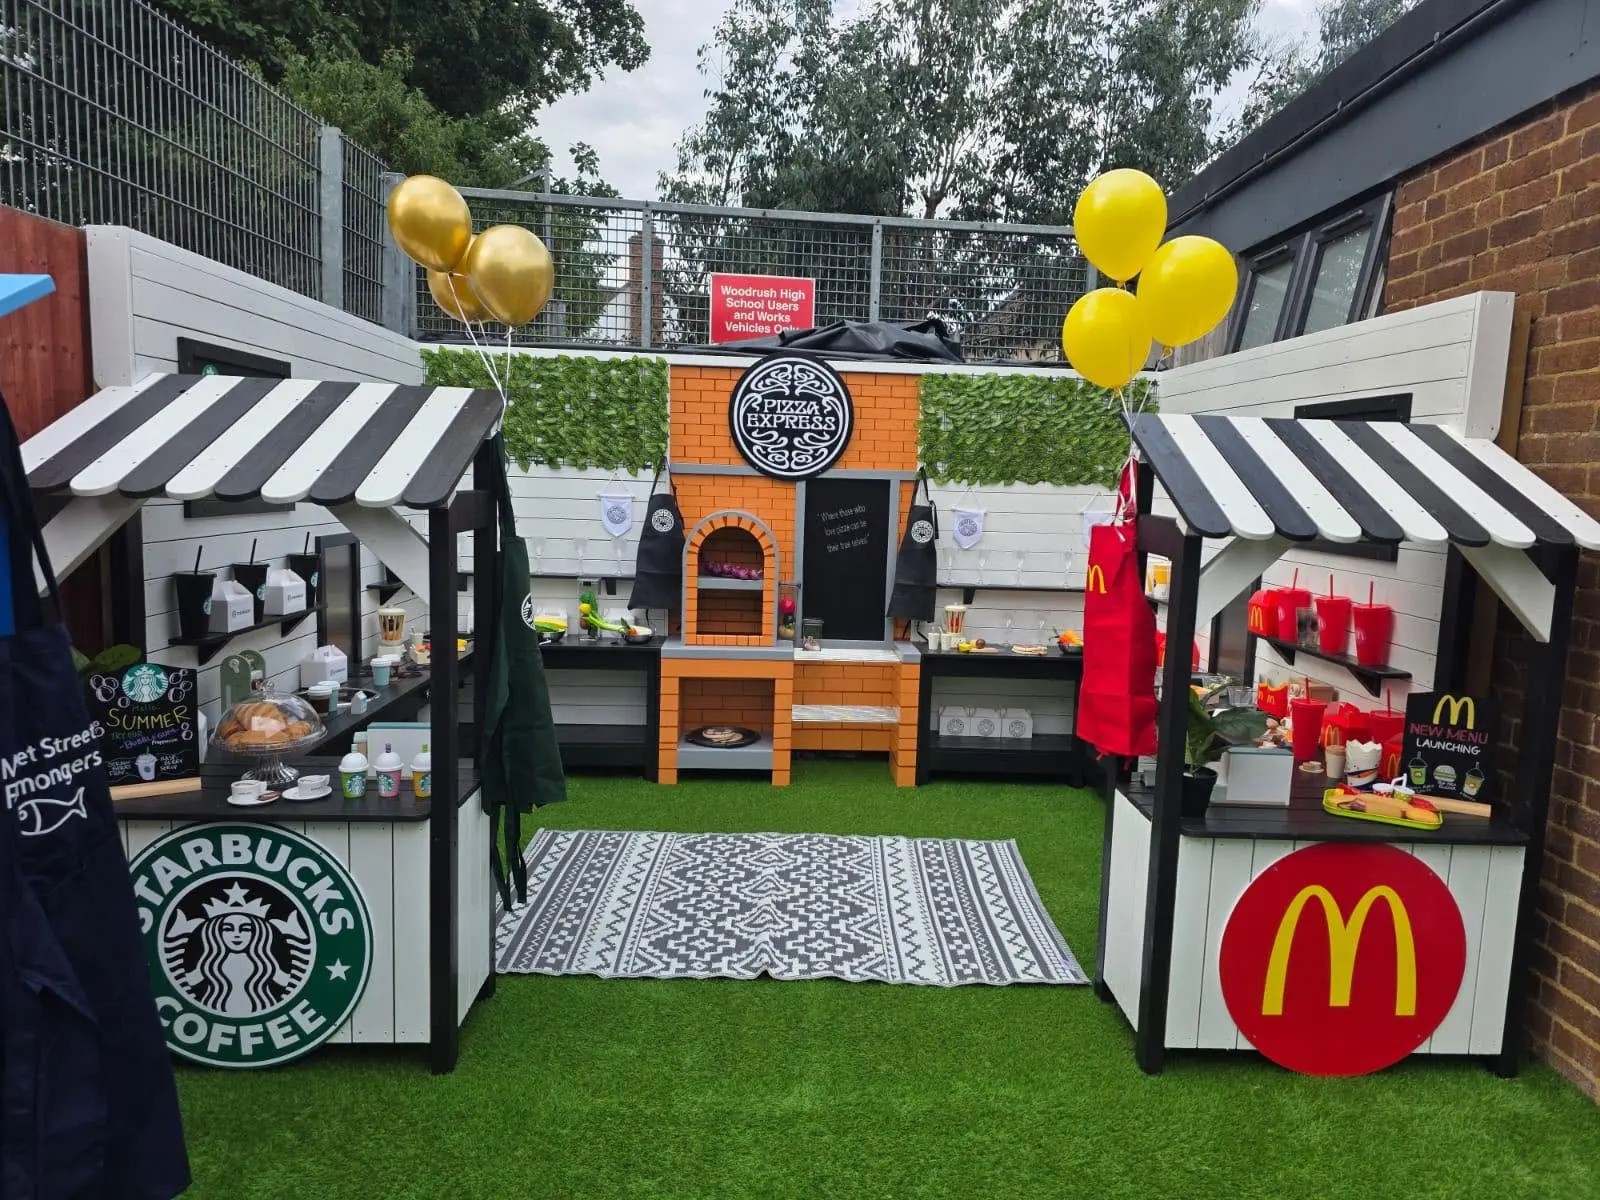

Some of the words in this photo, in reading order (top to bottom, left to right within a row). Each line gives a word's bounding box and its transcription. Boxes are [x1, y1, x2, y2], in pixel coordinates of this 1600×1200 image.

[720, 285, 777, 298] Woodrush
[780, 289, 805, 302] High
[725, 297, 765, 309] School
[767, 300, 800, 311] Users
[733, 310, 755, 320] and
[756, 311, 791, 323] Works
[724, 321, 771, 334] Vehicles
[763, 398, 820, 415] PIZZA
[746, 413, 836, 431] EXPRESS
[105, 704, 192, 730] SUMMER
[39, 721, 100, 759] Street
[1409, 722, 1444, 738] NEW
[1446, 726, 1489, 745] MENU
[1416, 737, 1481, 756] LAUNCHING
